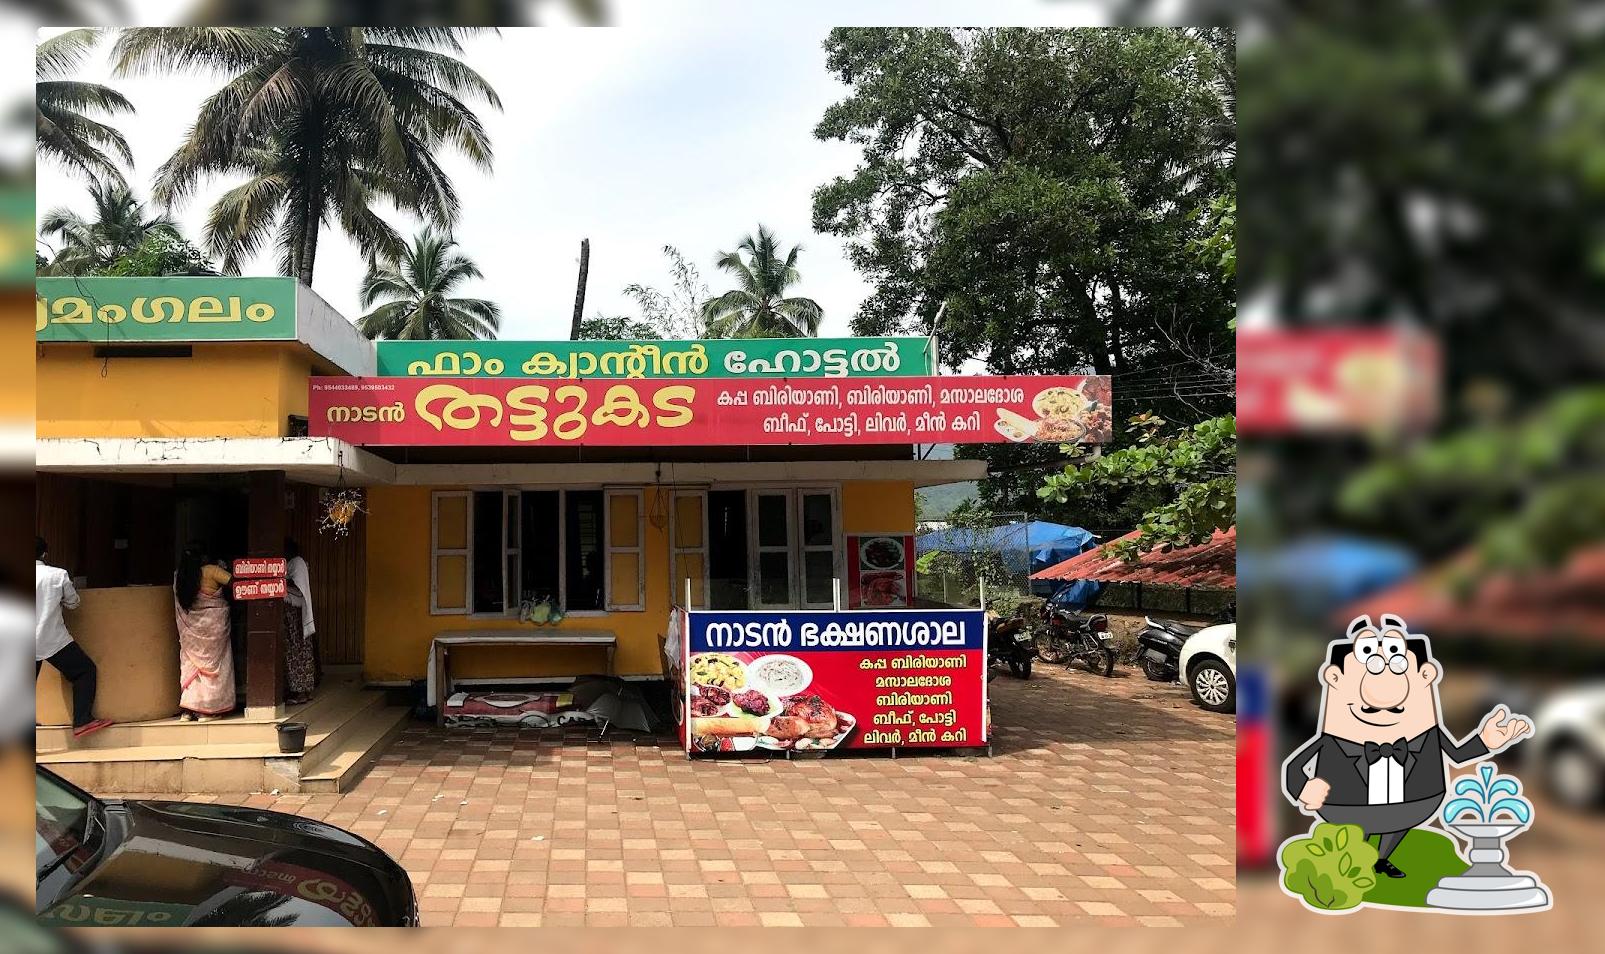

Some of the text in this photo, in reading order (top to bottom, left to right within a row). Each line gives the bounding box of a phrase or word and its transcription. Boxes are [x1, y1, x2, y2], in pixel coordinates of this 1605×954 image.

[407, 351, 504, 376] ഫാം
[723, 342, 901, 378] ഹോട്ടൽ
[717, 384, 1025, 409] കപ്പ ബിരിയാണി, ബിരിയാണി, മസാലദോശ
[327, 384, 696, 441] നാടൻ തട്ടുകട
[915, 411, 946, 432] മീൻ
[951, 410, 981, 431] കറി
[706, 618, 966, 647] നാടൻ ഭക്ഷണശാല
[859, 654, 967, 669] കപ്പ ബിരിയാണി
[875, 675, 952, 688] മസാലദോശ
[876, 691, 953, 706] ബിരിയാണി
[919, 709, 957, 727] പോട്ടി
[908, 728, 937, 743] മീൻ
[941, 727, 967, 742] കറി
